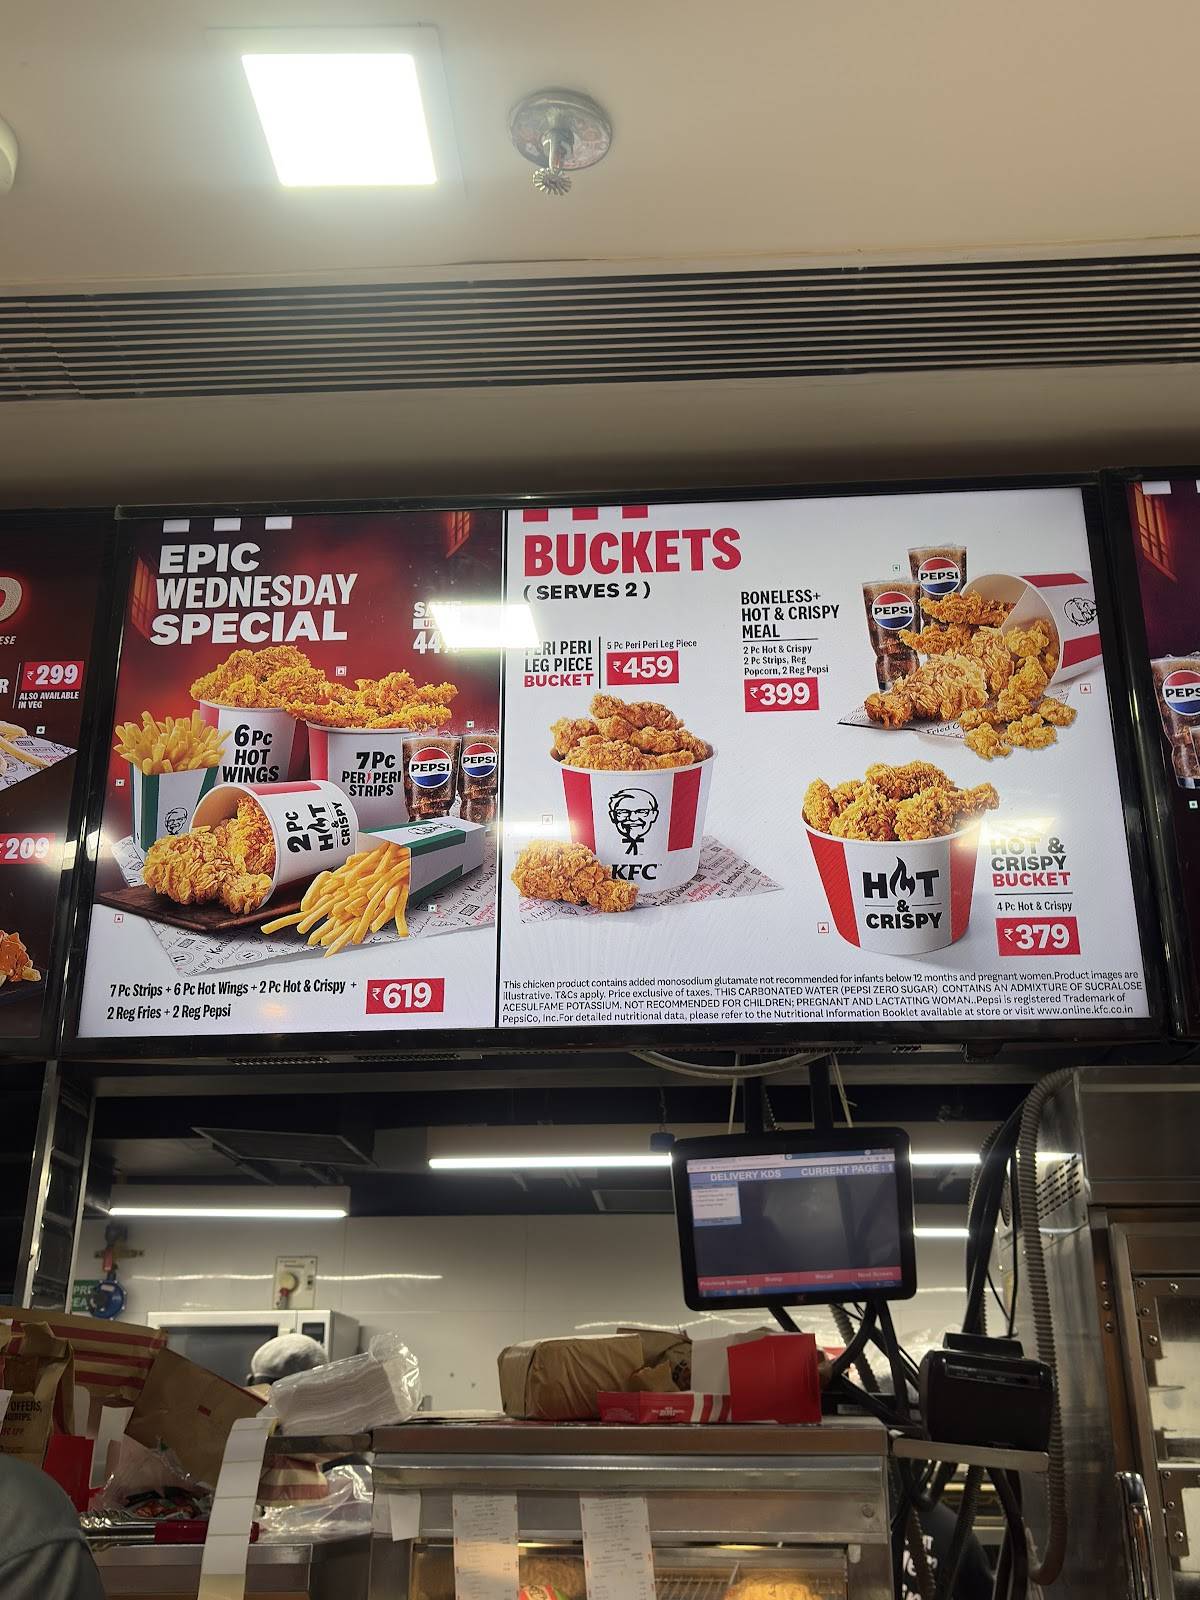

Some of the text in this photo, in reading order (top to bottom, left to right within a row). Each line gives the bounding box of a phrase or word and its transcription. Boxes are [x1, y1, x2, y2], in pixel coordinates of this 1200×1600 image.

[159, 543, 260, 574] EPIC
[524, 528, 742, 577] BUCKETS
[920, 572, 958, 580] PEPSI
[156, 574, 358, 609] WEDNESDAY
[537, 582, 638, 600] SERVES 2
[741, 589, 821, 605] BONELESS+
[742, 605, 839, 621] HOT & CRISPY
[874, 605, 912, 614] PEPSI
[150, 610, 348, 645] SPECIAL
[743, 624, 780, 639] MEAL
[561, 640, 591, 654] PERI
[607, 639, 697, 649] 5 Pc Peri Peri Leg Piece
[779, 645, 784, 653] &
[786, 645, 812, 653] Crispy
[525, 657, 592, 672] LEG PIECE
[613, 656, 673, 678] ₹459
[763, 656, 789, 665] Strips,
[791, 656, 806, 664] Reg
[27, 664, 78, 685] ₹299
[744, 665, 829, 677] Popcorn, 2 Reg Pepsi
[524, 674, 593, 687] BUCKET
[19, 691, 79, 700] ALSO AVAILABLE
[750, 682, 810, 706] ₹399
[235, 724, 272, 746] 6 Pc
[234, 749, 270, 765] HOT
[356, 752, 395, 769] 7 Pc
[462, 756, 496, 764] PEPSI
[223, 766, 279, 783] WINGS
[411, 763, 451, 773] PEPSI
[349, 784, 394, 797] STRIPS
[285, 811, 311, 852] 2 PC
[332, 802, 350, 846] CRISPY
[991, 837, 1066, 855] HOT &
[991, 856, 1066, 871] CRISPY
[612, 864, 657, 880] KFC
[993, 873, 1070, 887] BUCKET
[897, 900, 909, 912] &
[997, 901, 1072, 912] 4 Pc Hot & Crispy
[866, 912, 942, 930] CRISPY
[1005, 924, 1069, 948] ₹379
[110, 978, 345, 999] 7 Pc Strips 6 Pc Hot Wings 2 Pc Hot & Crispy
[504, 980, 521, 989] This
[523, 979, 554, 988] chicken
[557, 979, 589, 990] product
[591, 979, 627, 987] contains
[629, 978, 655, 986] added
[657, 977, 712, 986] monosodium
[714, 976, 757, 986] glutamate
[776, 975, 838, 984] recommended
[885, 974, 911, 982] below
[924, 973, 957, 981] months
[960, 973, 976, 981] and
[978, 972, 1018, 982] pregnant
[1091, 972, 1122, 980] images
[371, 982, 433, 1009] ₹619
[555, 991, 578, 999] T&Cs
[580, 991, 605, 1000] apply.
[608, 990, 630, 998] Price
[633, 989, 673, 997] exclusive
[686, 988, 712, 996] taxes.
[717, 988, 736, 996] THIS
[739, 987, 802, 995] CARBONATED
[840, 986, 871, 995] (PEPSI
[873, 986, 898, 994] ZERO
[901, 985, 938, 994] SUGAR)
[943, 984, 992, 993] CONTAINS
[1011, 983, 1067, 991] ADMIXTURE
[1070, 983, 1083, 991] OF
[1085, 982, 1142, 990] SUCRALOSE
[107, 1004, 231, 1022] 2 Reg Fries 2 Reg Pepsi
[503, 1014, 541, 1024] PepsiCo,
[576, 1013, 612, 1021] detailed
[614, 1012, 662, 1021] nutritional
[664, 1012, 687, 1021] data,
[690, 1011, 716, 1021] please
[721, 1010, 742, 1018] refer
[757, 1010, 771, 1018] the
[774, 1010, 824, 1018] Nutritional
[826, 1009, 880, 1017] Information
[883, 1008, 918, 1016] Booklet
[921, 1007, 962, 1016] available
[977, 1007, 1000, 1015] store
[1016, 1006, 1034, 1014] visit
[1037, 1005, 1133, 1015] www.online.kfc.co.in
[711, 1169, 781, 1181] DELIVERY KDS
[801, 1164, 879, 1176] CURRENT PAGE
